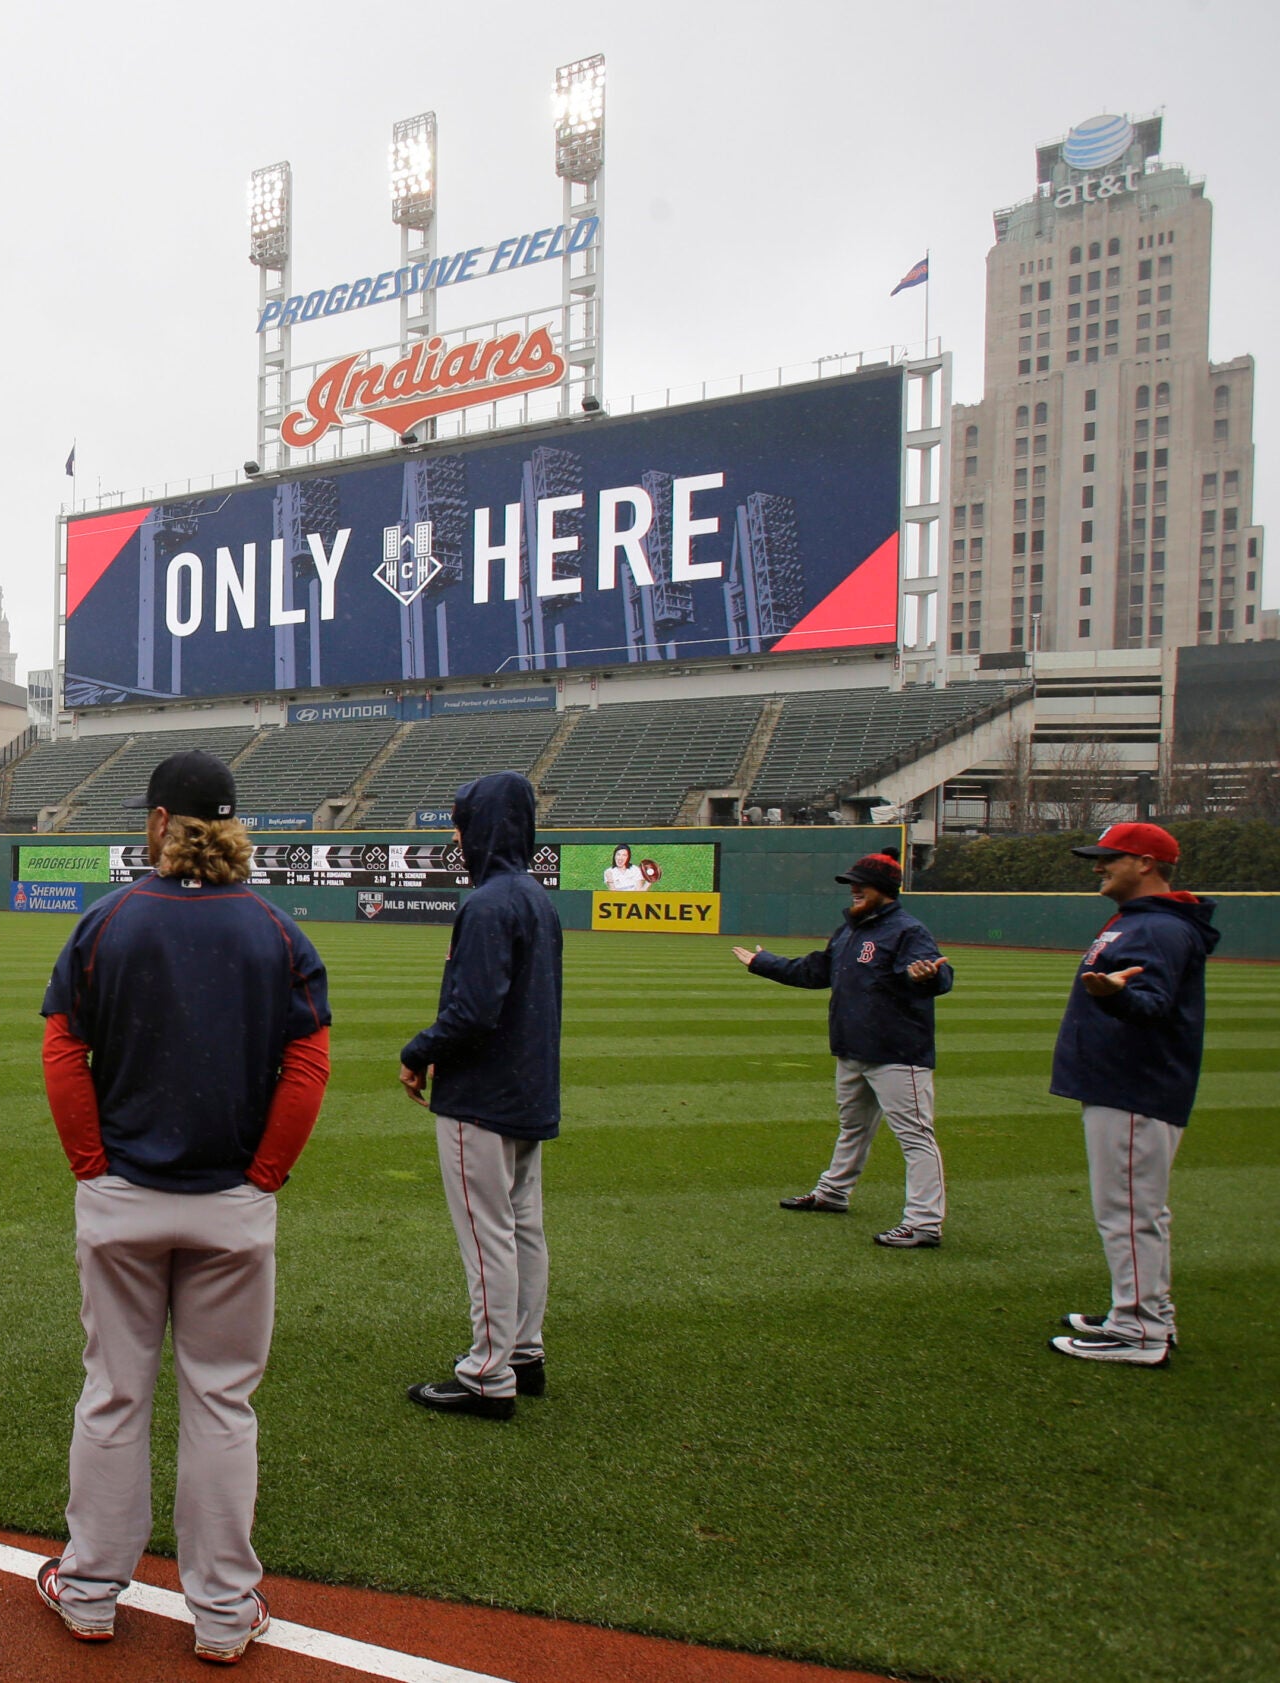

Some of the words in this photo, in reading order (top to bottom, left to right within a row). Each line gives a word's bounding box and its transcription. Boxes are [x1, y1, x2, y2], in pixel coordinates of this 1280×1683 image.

[1053, 165, 1141, 209] at&t
[256, 247, 485, 333] PROGRESSIVE
[489, 216, 600, 275] FIELD
[279, 321, 567, 449] Indians
[164, 527, 353, 638] ONLY
[472, 471, 725, 605] HERE
[322, 704, 387, 719] HYUNDAI
[27, 857, 102, 870] PROGRESSIVE
[455, 876, 469, 885] 4:10
[543, 877, 558, 886] 4:10
[30, 884, 77, 897] SHERWIN
[359, 893, 382, 901] MLB
[292, 907, 308, 916] 370
[384, 900, 405, 910] MLB
[406, 900, 457, 911] NETWORK
[598, 902, 713, 921] STANLEY
[856, 941, 876, 964] B
